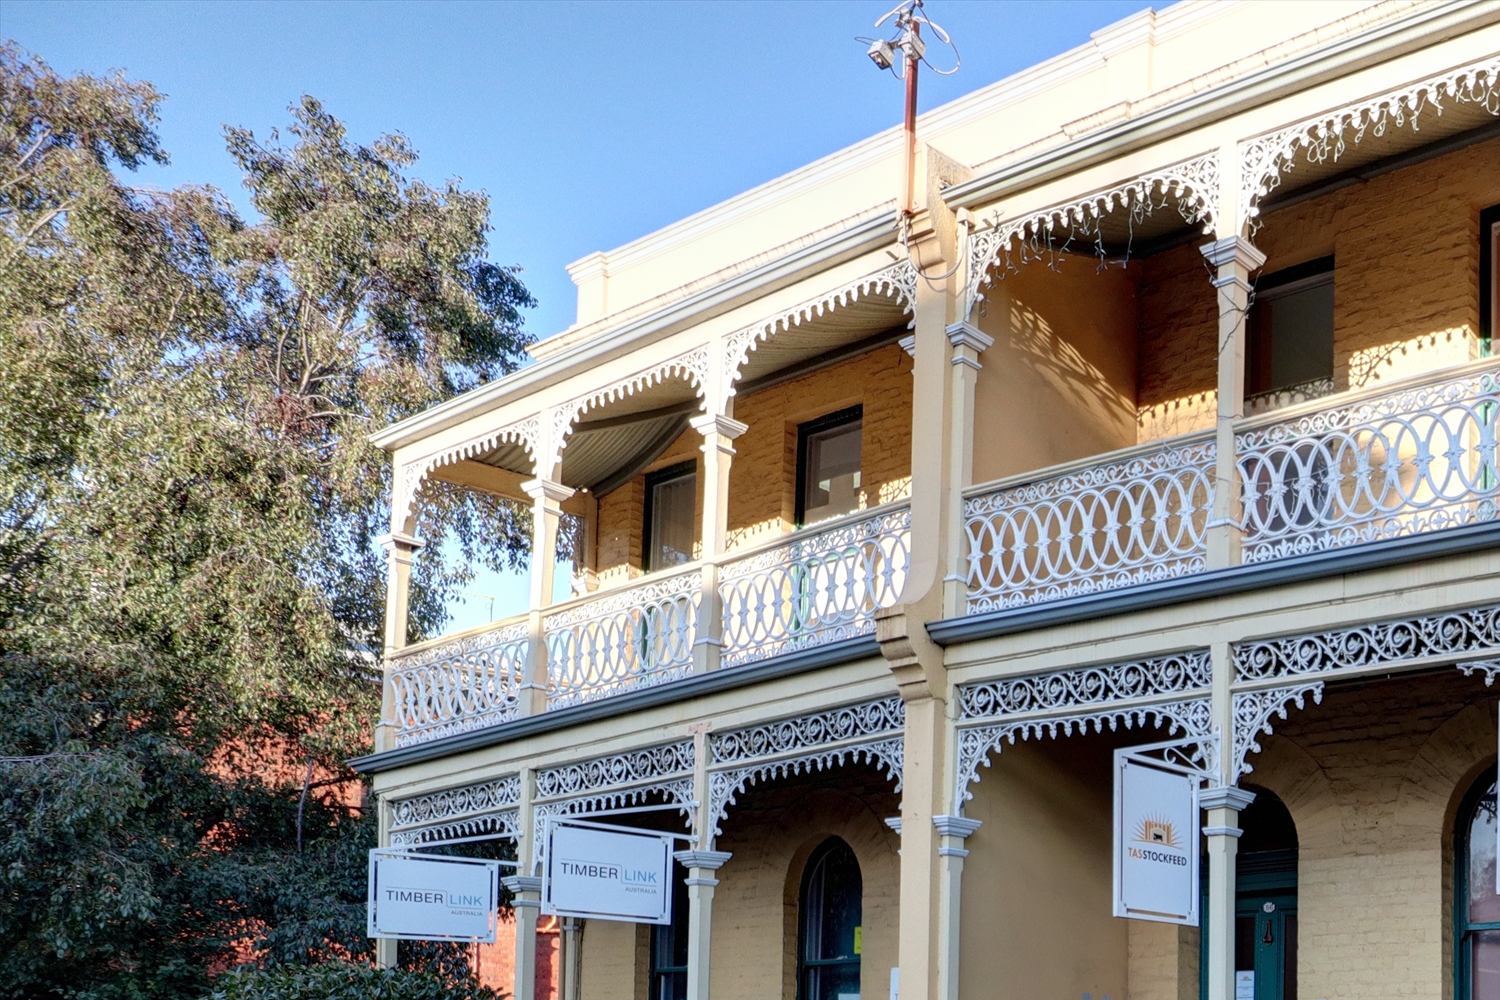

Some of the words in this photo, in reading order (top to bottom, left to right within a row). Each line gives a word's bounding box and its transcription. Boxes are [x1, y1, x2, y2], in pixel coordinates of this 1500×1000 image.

[1128, 847, 1187, 866] TASSTOCKFEED
[560, 862, 618, 879] TIMBER
[624, 869, 657, 883] LINK
[385, 890, 444, 904] TIMBER
[450, 894, 483, 906] LINK
